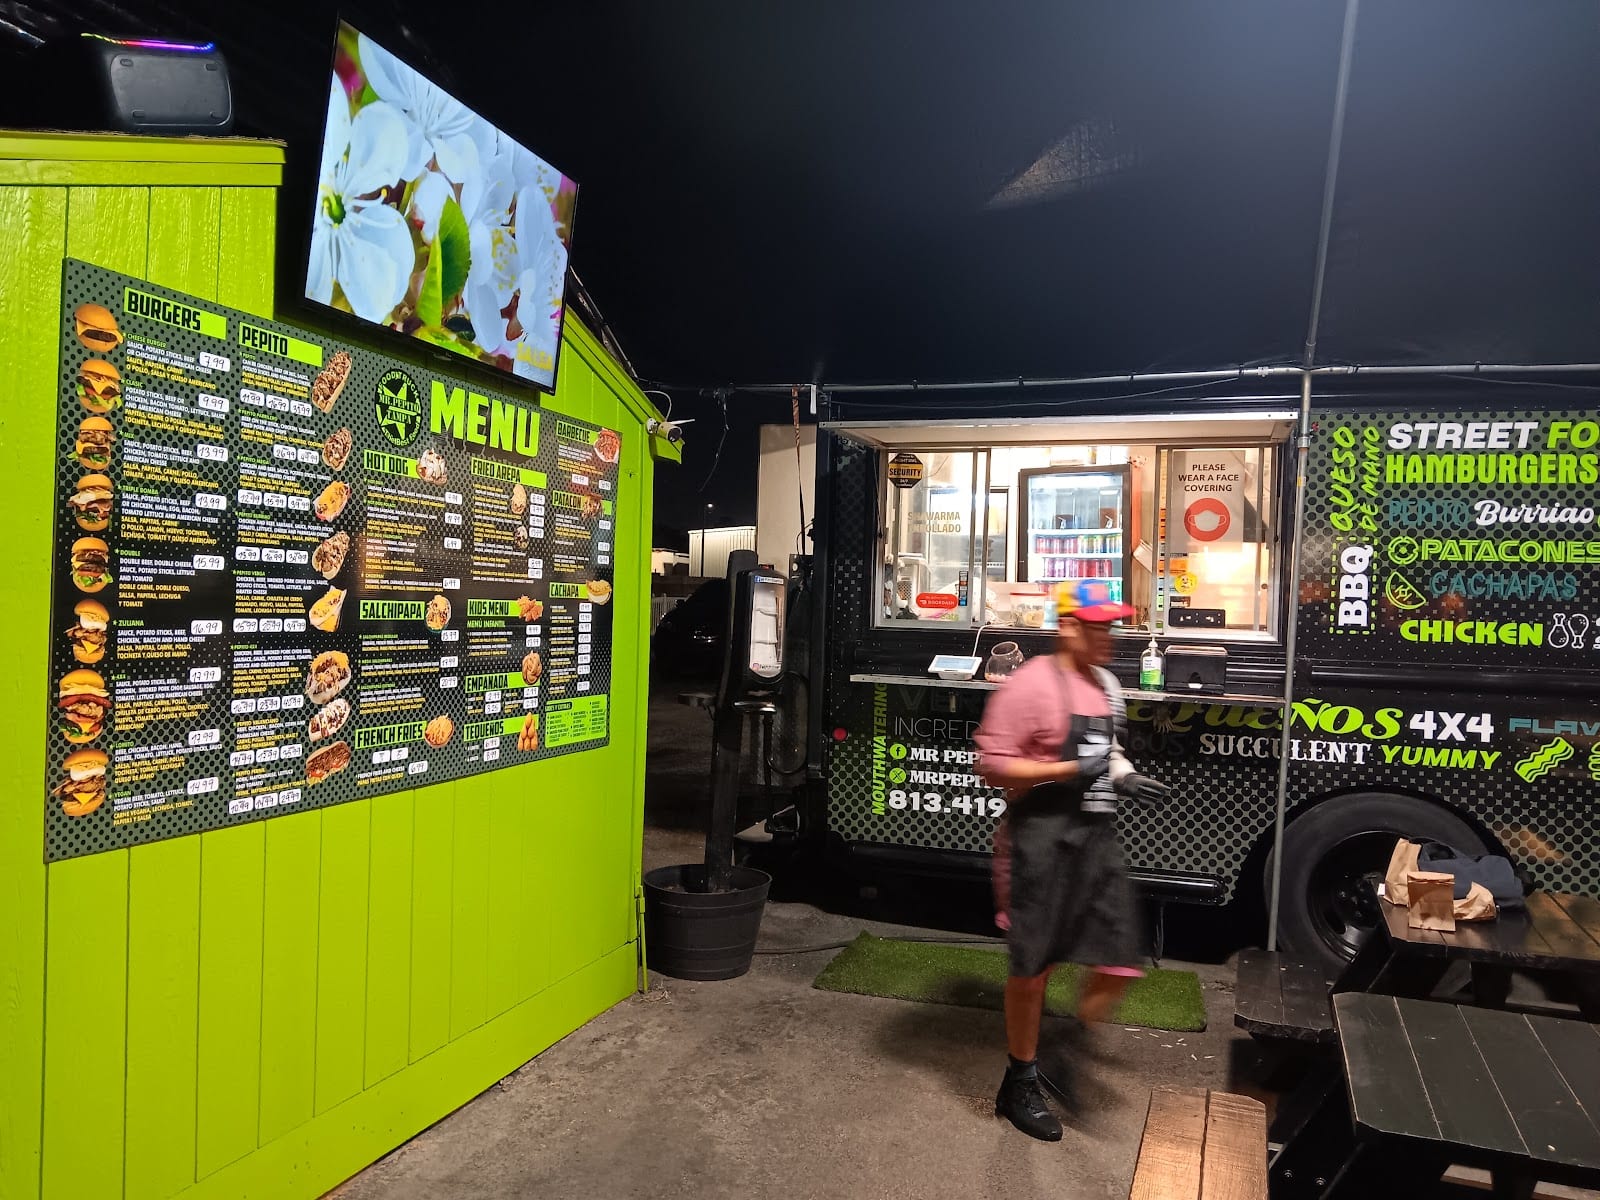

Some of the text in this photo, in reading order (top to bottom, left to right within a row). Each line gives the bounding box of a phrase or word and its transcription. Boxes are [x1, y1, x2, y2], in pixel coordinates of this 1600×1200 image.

[128, 291, 201, 331] BURGERS
[128, 334, 167, 348] CHEESE BURGER
[242, 326, 288, 356] PEPITO
[158, 356, 170, 365] AND
[430, 380, 540, 457] MENU
[557, 422, 590, 443] BARBECUE
[1387, 420, 1600, 449] STREET FO
[366, 452, 409, 475] HOT DOG
[473, 460, 521, 483] FRIED AREPA
[889, 468, 921, 477] SECURITY
[1192, 463, 1226, 472] PLEASE
[1361, 426, 1381, 496] MANO
[1385, 454, 1599, 485] HAMBURGERS
[1178, 474, 1239, 482] WEAR A FACE
[1184, 484, 1233, 493] COVERING
[1329, 426, 1357, 532] QUESO
[554, 492, 582, 509] PATACON
[1388, 499, 1594, 528] PEPITO Burriao
[1421, 539, 1600, 563] PATACONES
[551, 584, 579, 597] CACHAPA
[1338, 544, 1375, 627] BBQ
[1429, 571, 1578, 601] CACHAPAS
[362, 602, 422, 619] SALCHIPAPA
[469, 601, 509, 616] KIDS MENU
[1400, 620, 1544, 647] CHICKEN
[467, 677, 508, 692] EMPANADA
[357, 723, 423, 748] FRENCH FRIES
[465, 720, 504, 740] TEQUEÑOS
[1409, 710, 1600, 743] 4X4 FLAV
[872, 683, 888, 815] MOUTHWATERING
[909, 746, 940, 763] MR
[1199, 733, 1373, 765] SUCCULENT
[1380, 744, 1502, 770] YUMMY
[908, 769, 1003, 790] MRPEPIT
[888, 790, 1008, 818] 813.419
